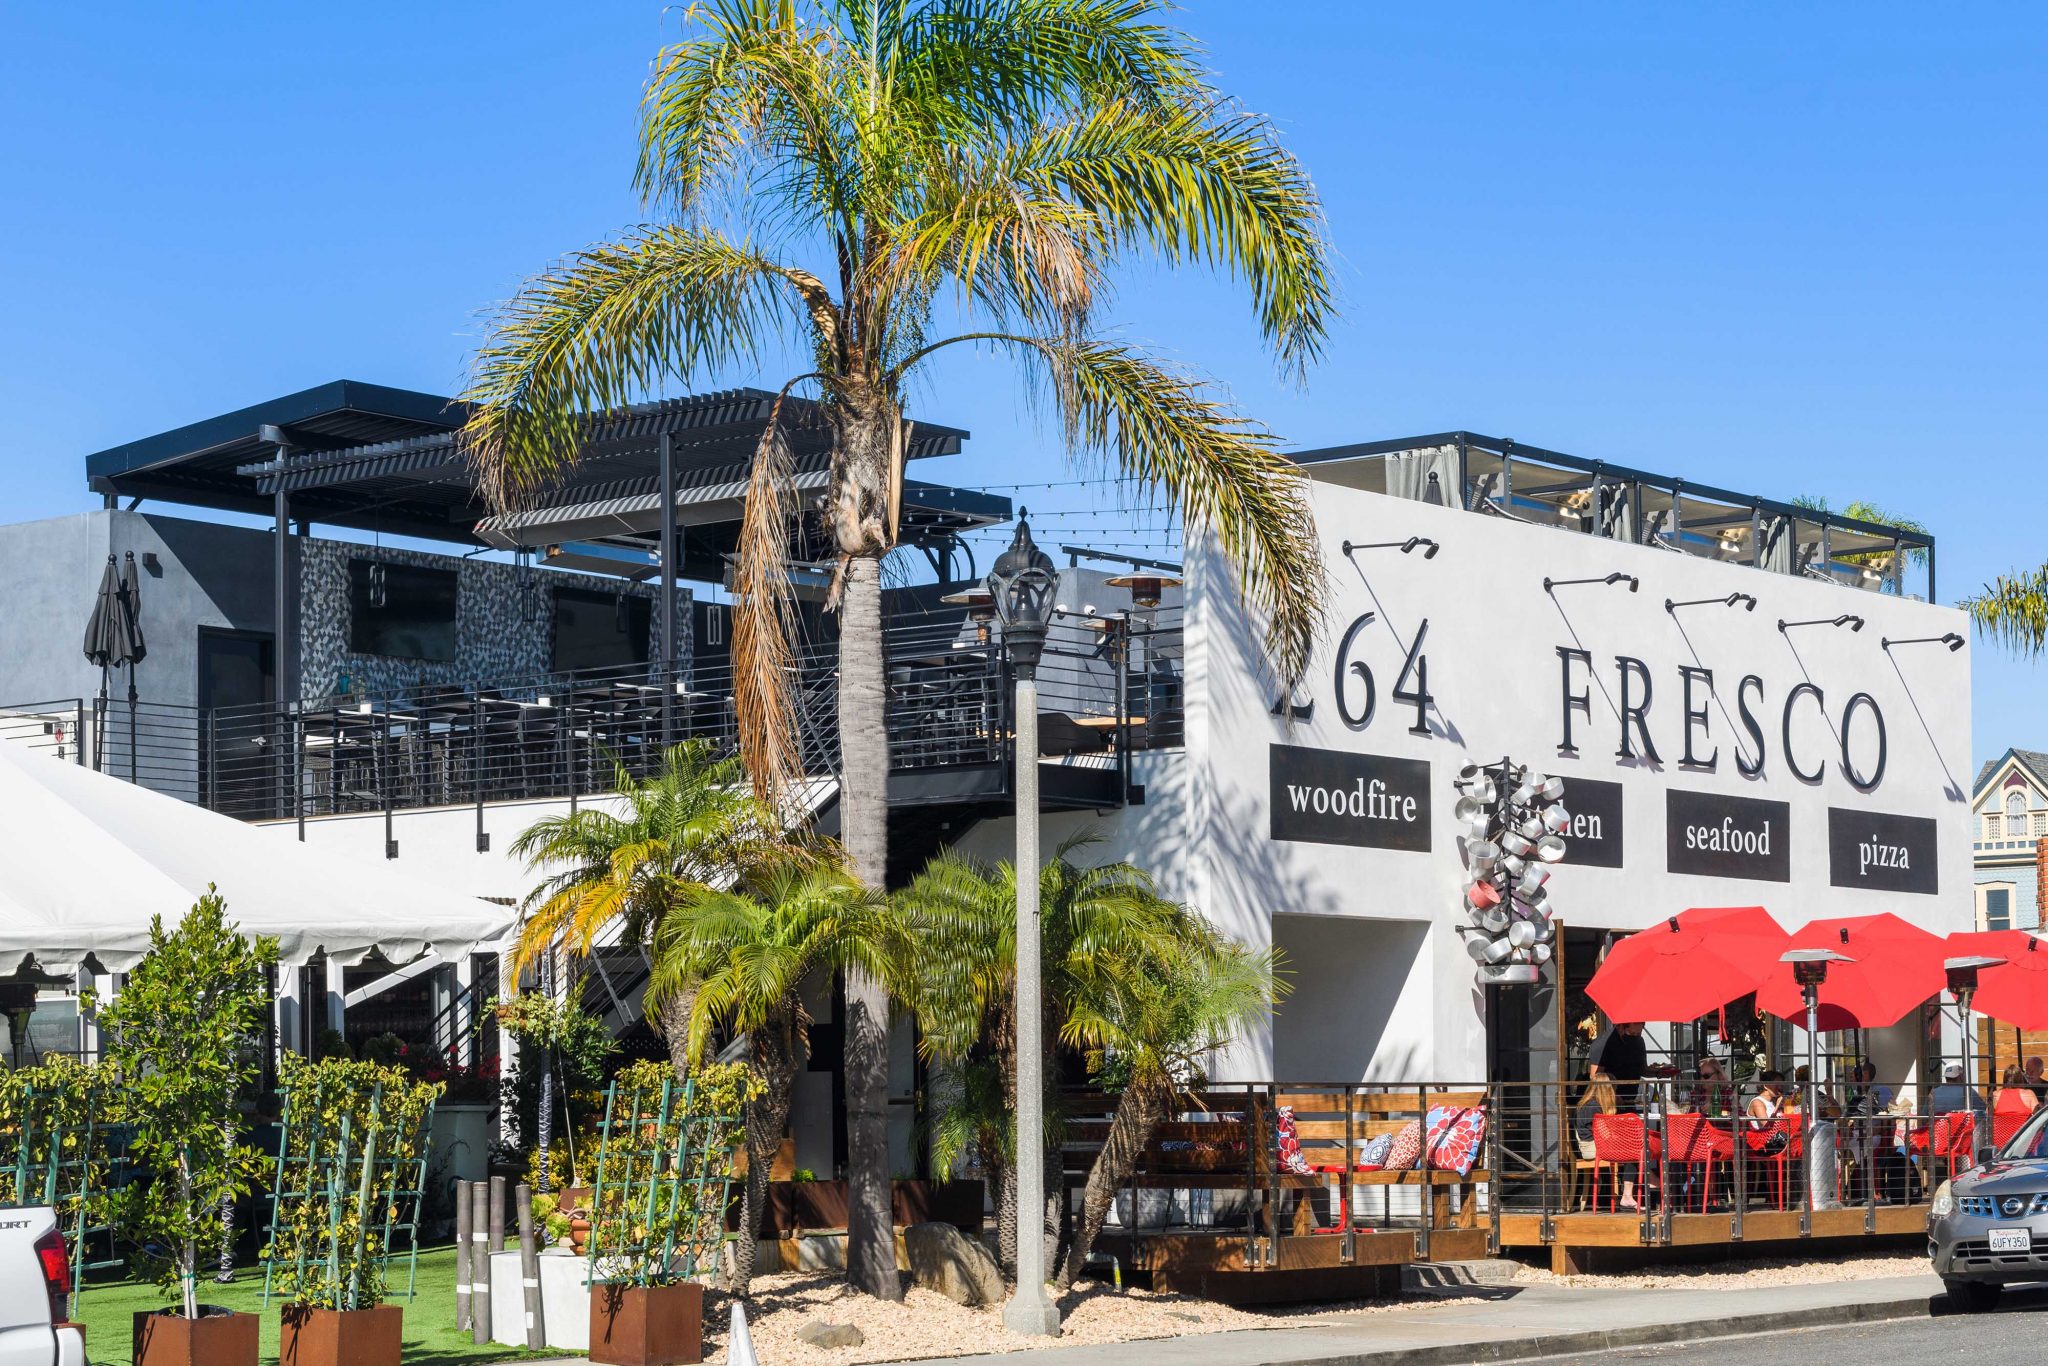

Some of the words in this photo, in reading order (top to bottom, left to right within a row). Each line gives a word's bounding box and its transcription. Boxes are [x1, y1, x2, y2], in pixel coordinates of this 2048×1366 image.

[1556, 645, 1887, 791] FRESCO
[1287, 777, 1417, 822] woodfire
[1686, 816, 1771, 856] seafood
[1859, 834, 1910, 876] pizza
[1992, 1237, 2027, 1248] 6UFY350
